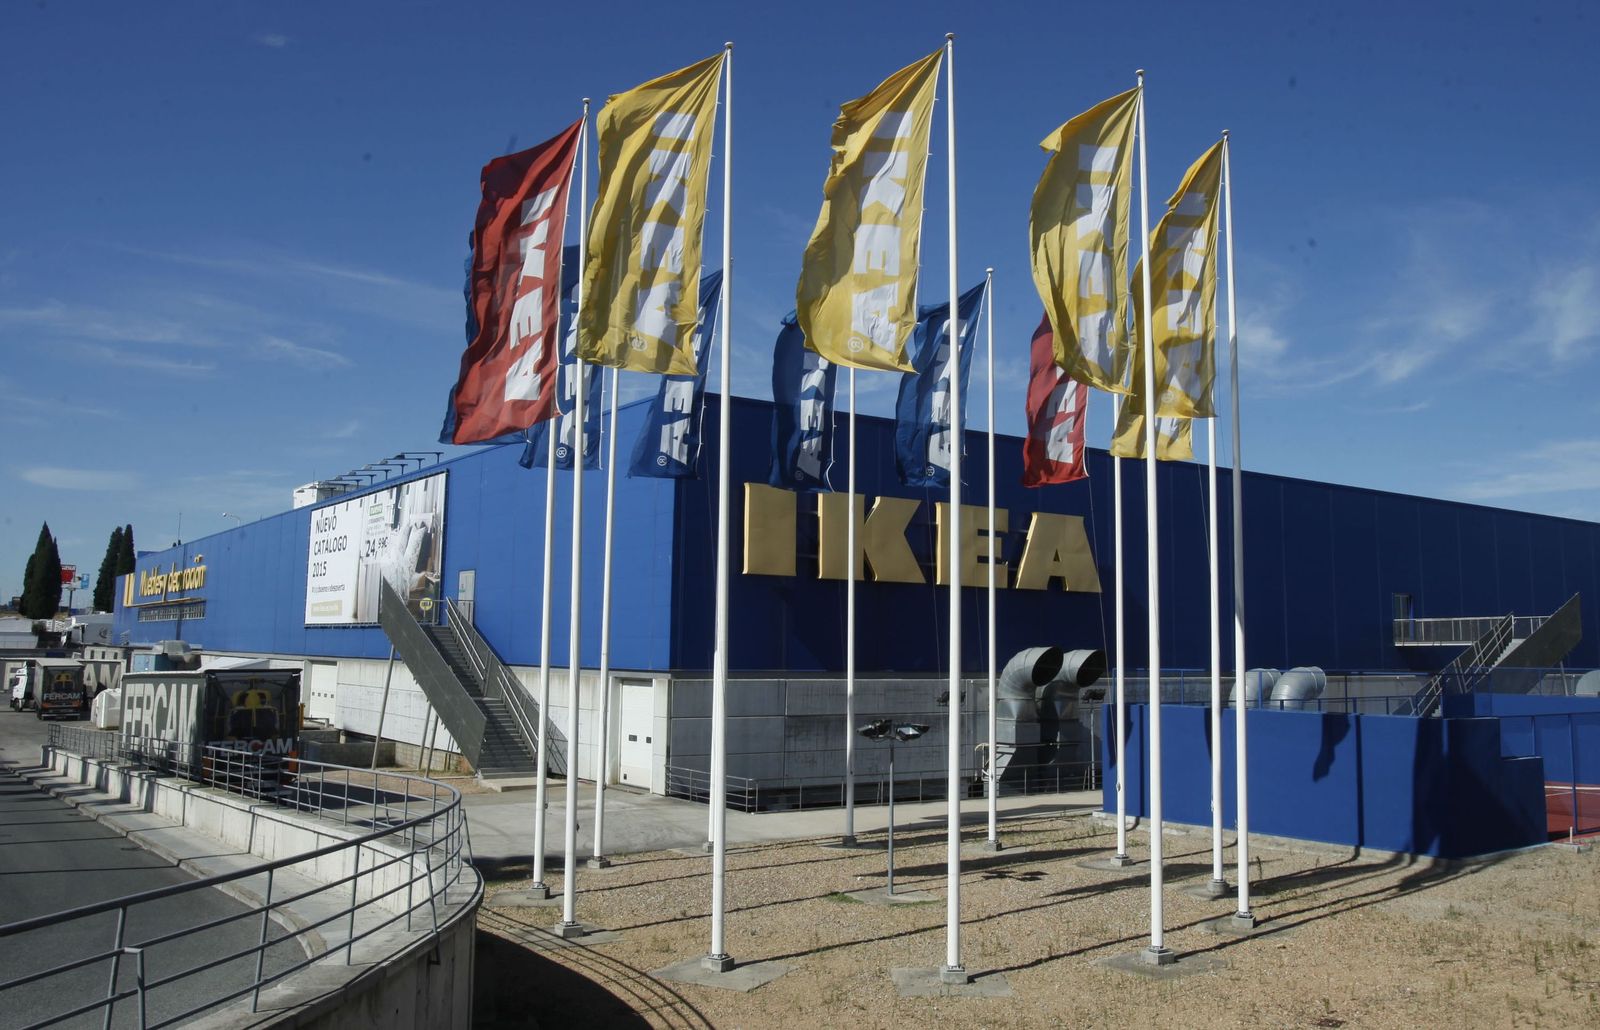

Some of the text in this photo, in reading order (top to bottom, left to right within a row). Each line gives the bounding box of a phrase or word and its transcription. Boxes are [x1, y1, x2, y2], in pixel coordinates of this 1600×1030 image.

[504, 184, 559, 402] IKEA
[634, 112, 697, 346] IKEA
[851, 110, 913, 353] IKEA
[1076, 144, 1119, 377] IKEA
[1166, 192, 1206, 399] IKEA
[312, 561, 327, 577] 2015
[313, 534, 348, 555] CATÁLOGO
[315, 515, 337, 534] NUEVO
[742, 482, 1103, 593] IKEA
[122, 683, 198, 762] FERCAM
